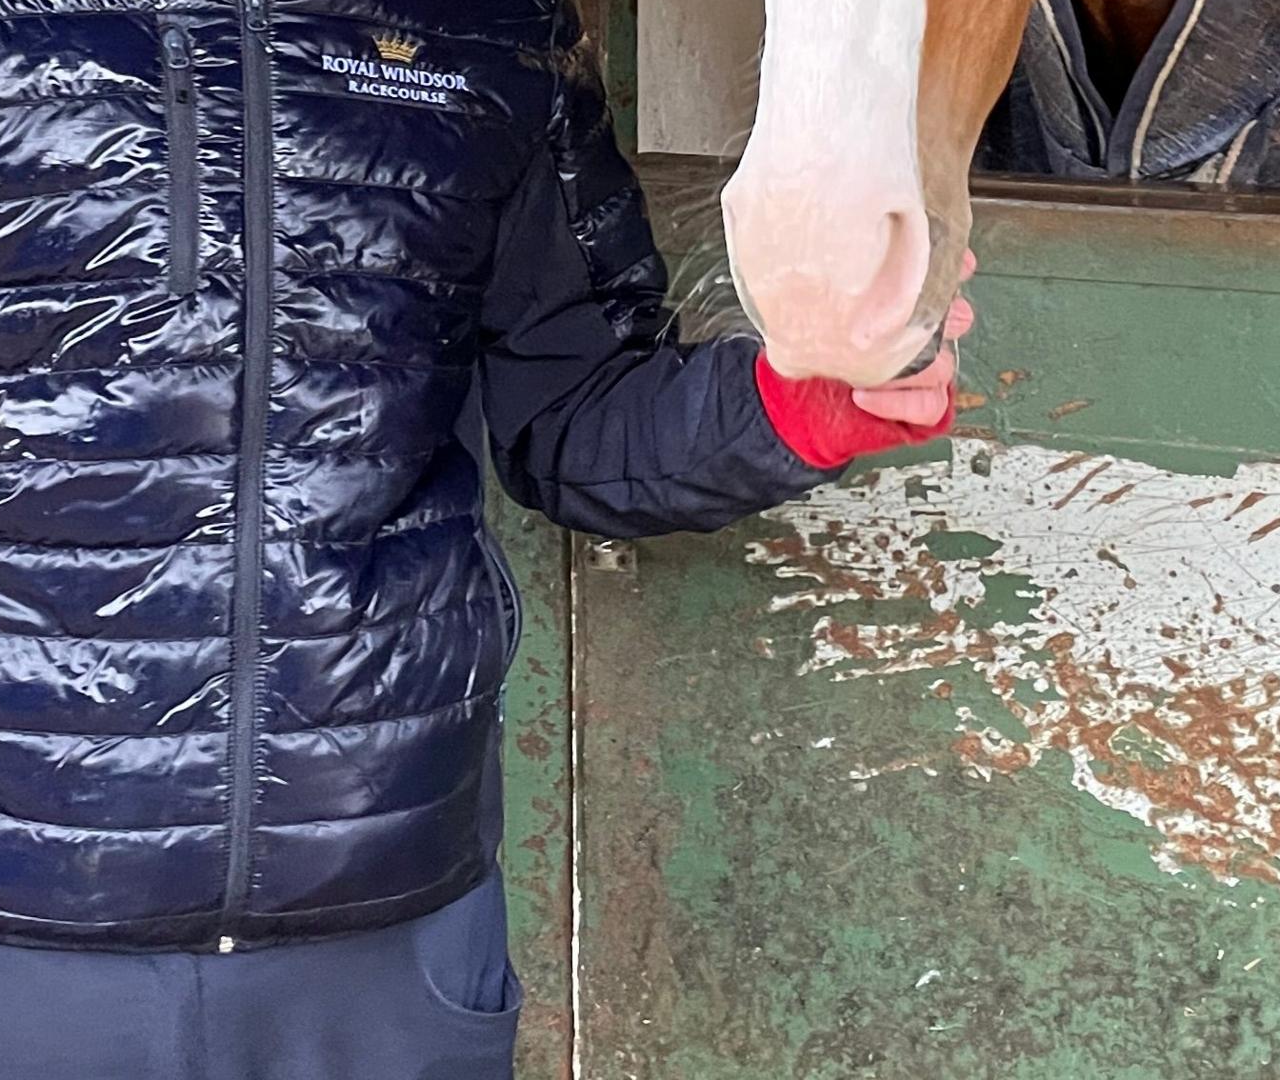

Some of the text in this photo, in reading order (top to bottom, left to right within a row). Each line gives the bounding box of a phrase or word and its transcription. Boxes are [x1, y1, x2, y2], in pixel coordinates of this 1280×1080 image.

[321, 55, 470, 91] ROYAL WINDSOR
[348, 80, 447, 104] RACECOURSE
